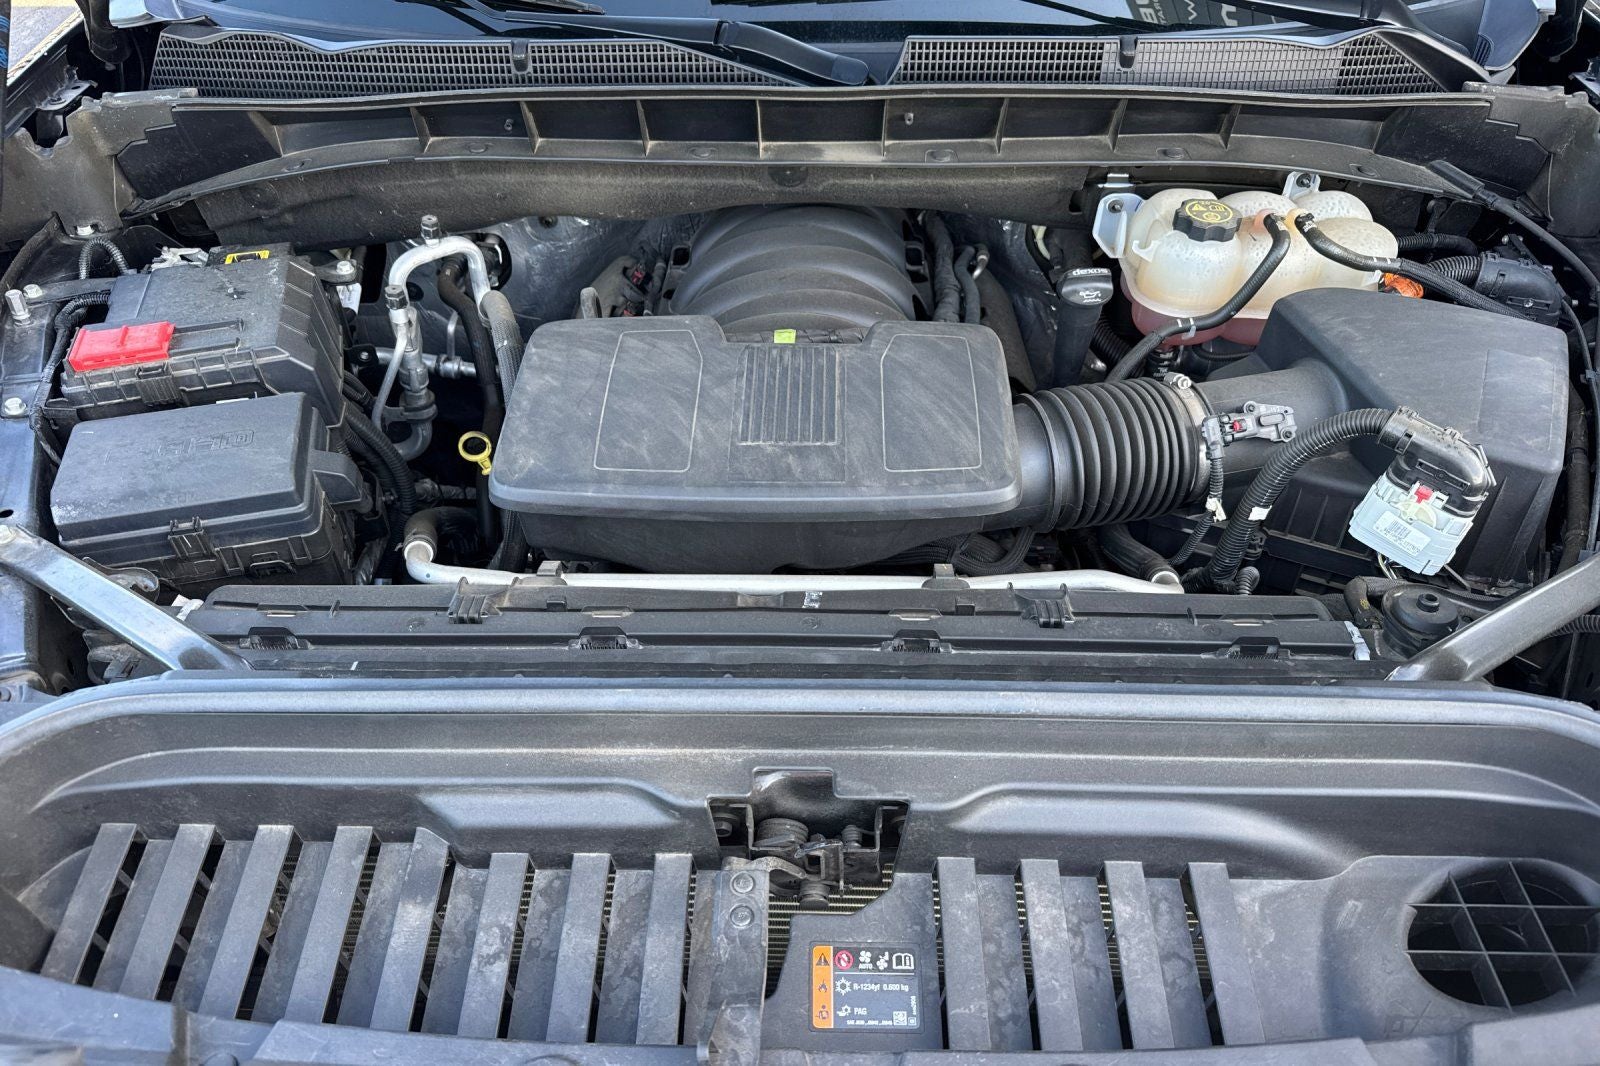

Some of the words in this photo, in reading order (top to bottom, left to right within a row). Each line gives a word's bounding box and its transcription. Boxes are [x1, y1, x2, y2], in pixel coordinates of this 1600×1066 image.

[1072, 268, 1108, 276] dexos
[853, 983, 880, 992] R-1234yf
[900, 984, 909, 992] kg
[854, 1007, 867, 1015] PAG
